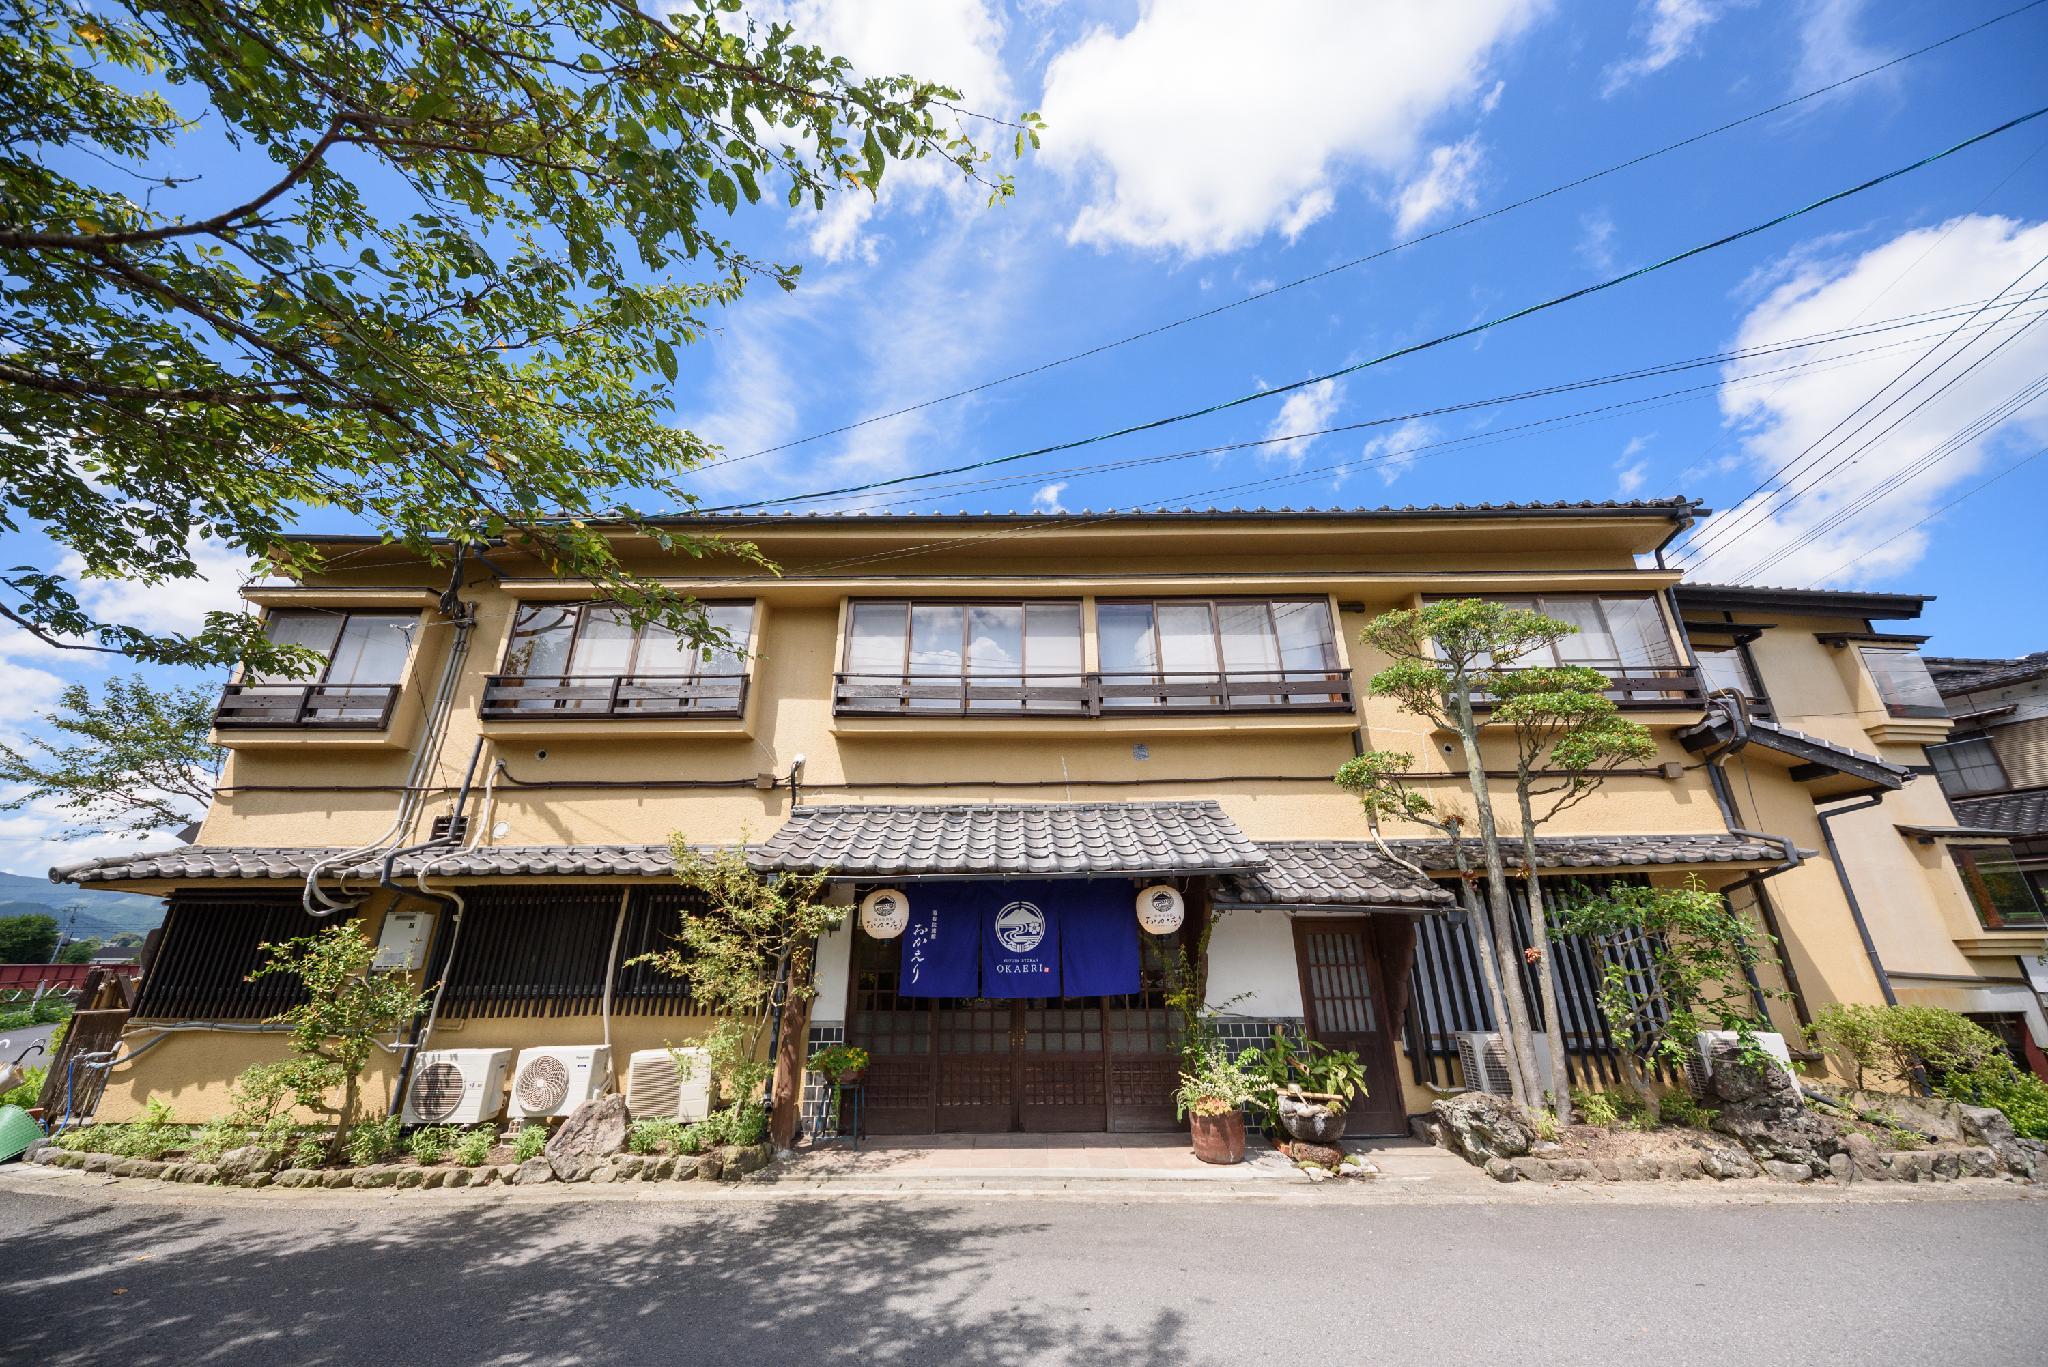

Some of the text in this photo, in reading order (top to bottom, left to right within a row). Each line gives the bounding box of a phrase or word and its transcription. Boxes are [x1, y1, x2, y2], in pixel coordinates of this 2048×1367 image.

[911, 924, 928, 984] おかえり
[996, 964, 1043, 973] OKAERI
